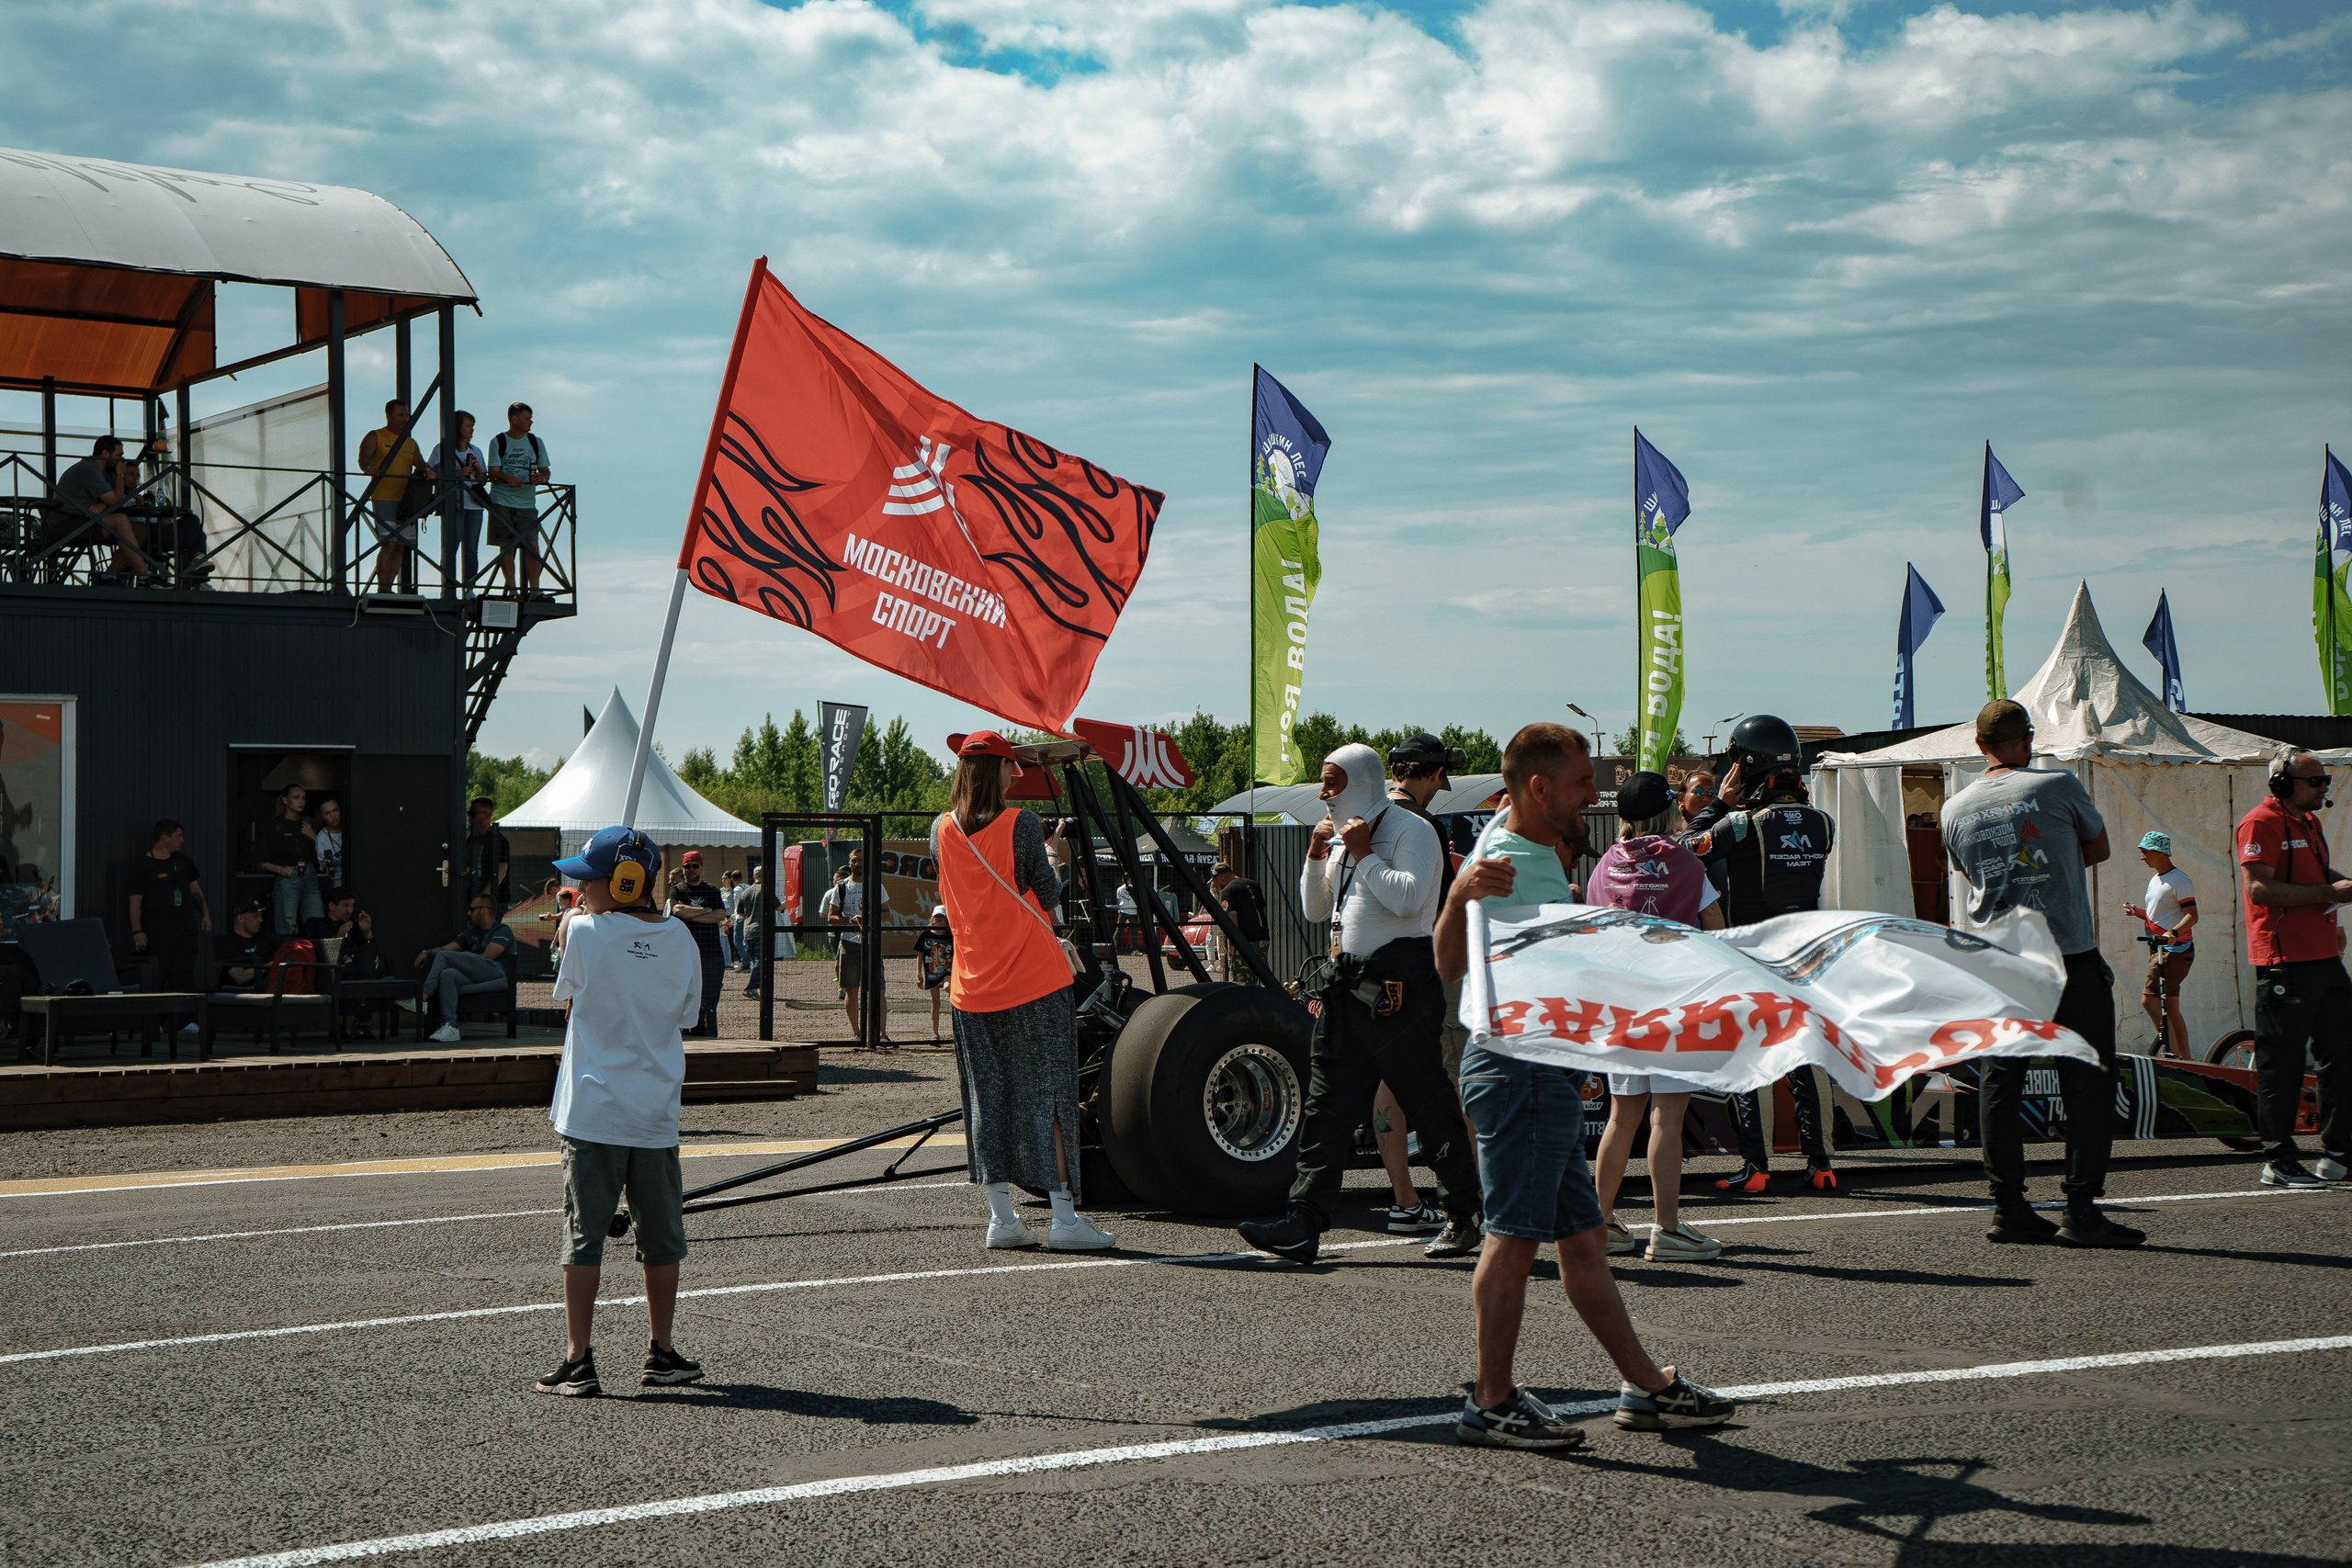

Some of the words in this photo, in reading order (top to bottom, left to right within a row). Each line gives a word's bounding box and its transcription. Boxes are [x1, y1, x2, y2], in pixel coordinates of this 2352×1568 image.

[1290, 451, 1307, 478] ЛЕС
[842, 533, 1007, 629] МОСКОВСКИЙ
[871, 592, 956, 649] СПОРТ
[1281, 558, 1308, 671] ВОДА!
[1646, 610, 1682, 717] ВОДА!
[830, 708, 848, 773] RACE
[828, 774, 839, 809] GO
